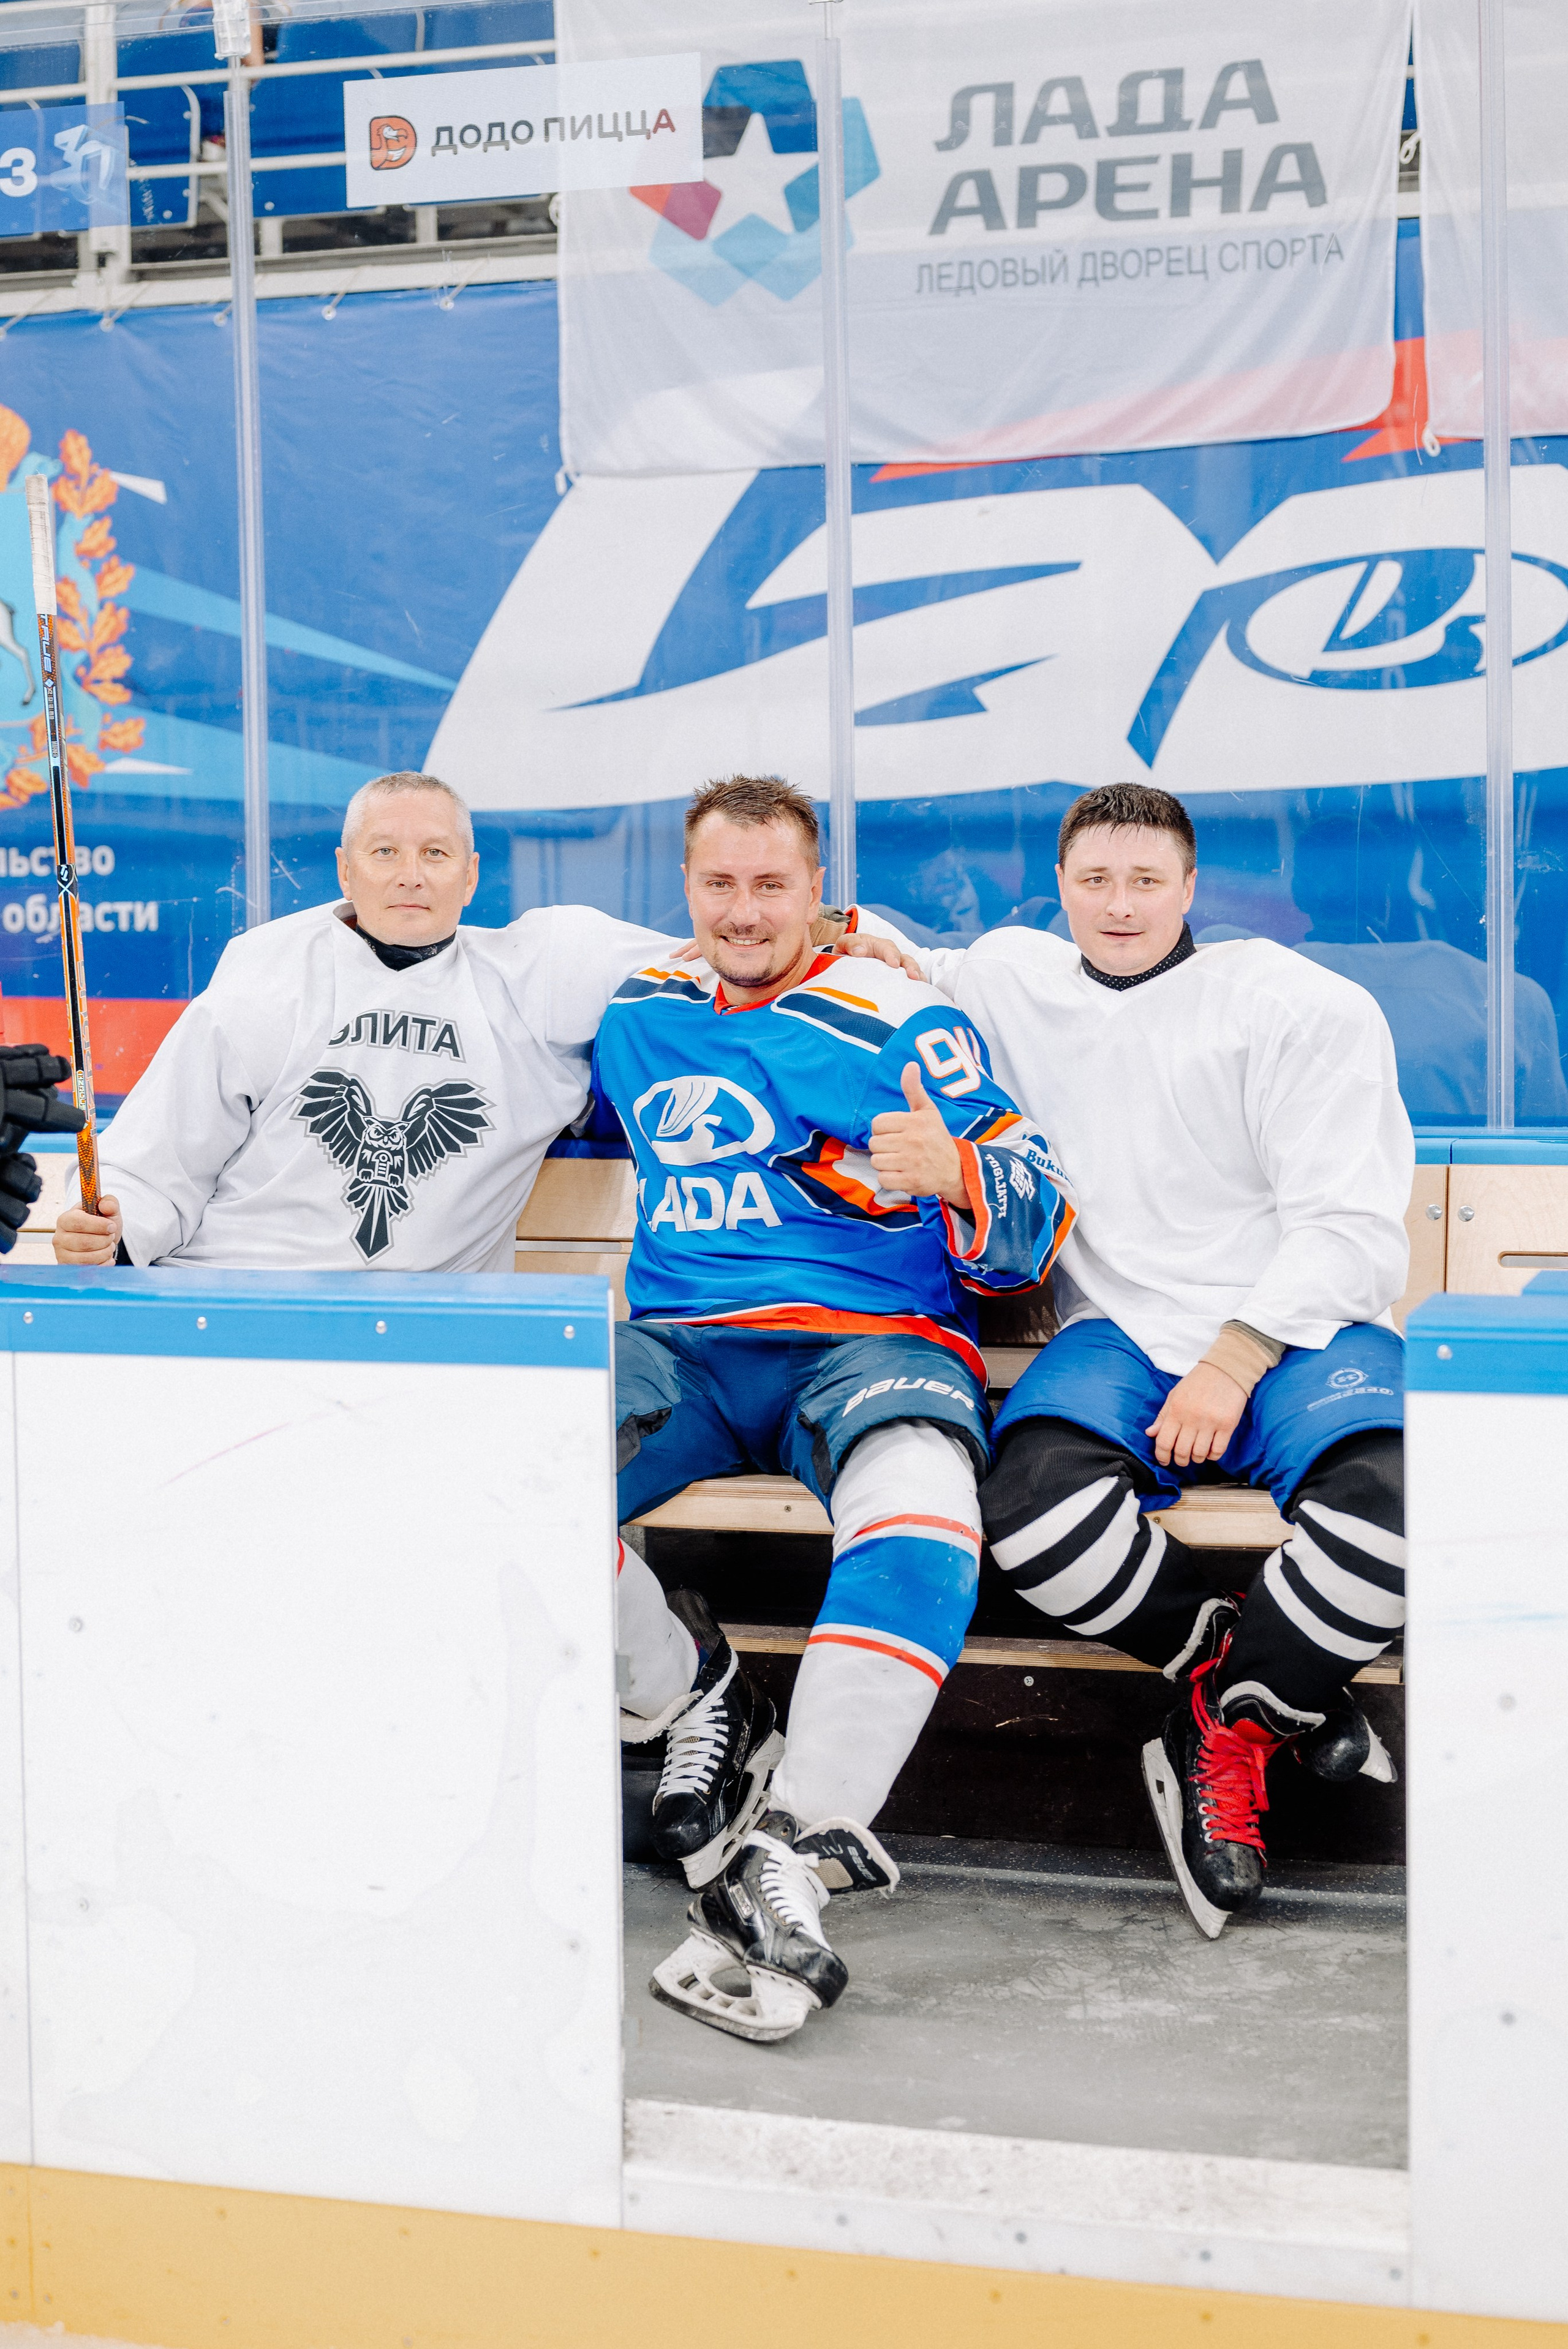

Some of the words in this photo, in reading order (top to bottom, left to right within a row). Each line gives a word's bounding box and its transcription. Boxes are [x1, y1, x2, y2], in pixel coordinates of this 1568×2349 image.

[431, 120, 533, 156] ДОДО
[544, 108, 676, 142] ПИЦЦА
[934, 59, 1280, 152] ЛАДА
[928, 142, 1327, 236] АРЕНА
[916, 248, 1069, 296] ЛЕДОВЫЙ
[1077, 246, 1208, 288] ДВОРЕЦ
[1218, 233, 1344, 273] СПОРТА
[984, 1153, 1007, 1219] TOGLIATTI
